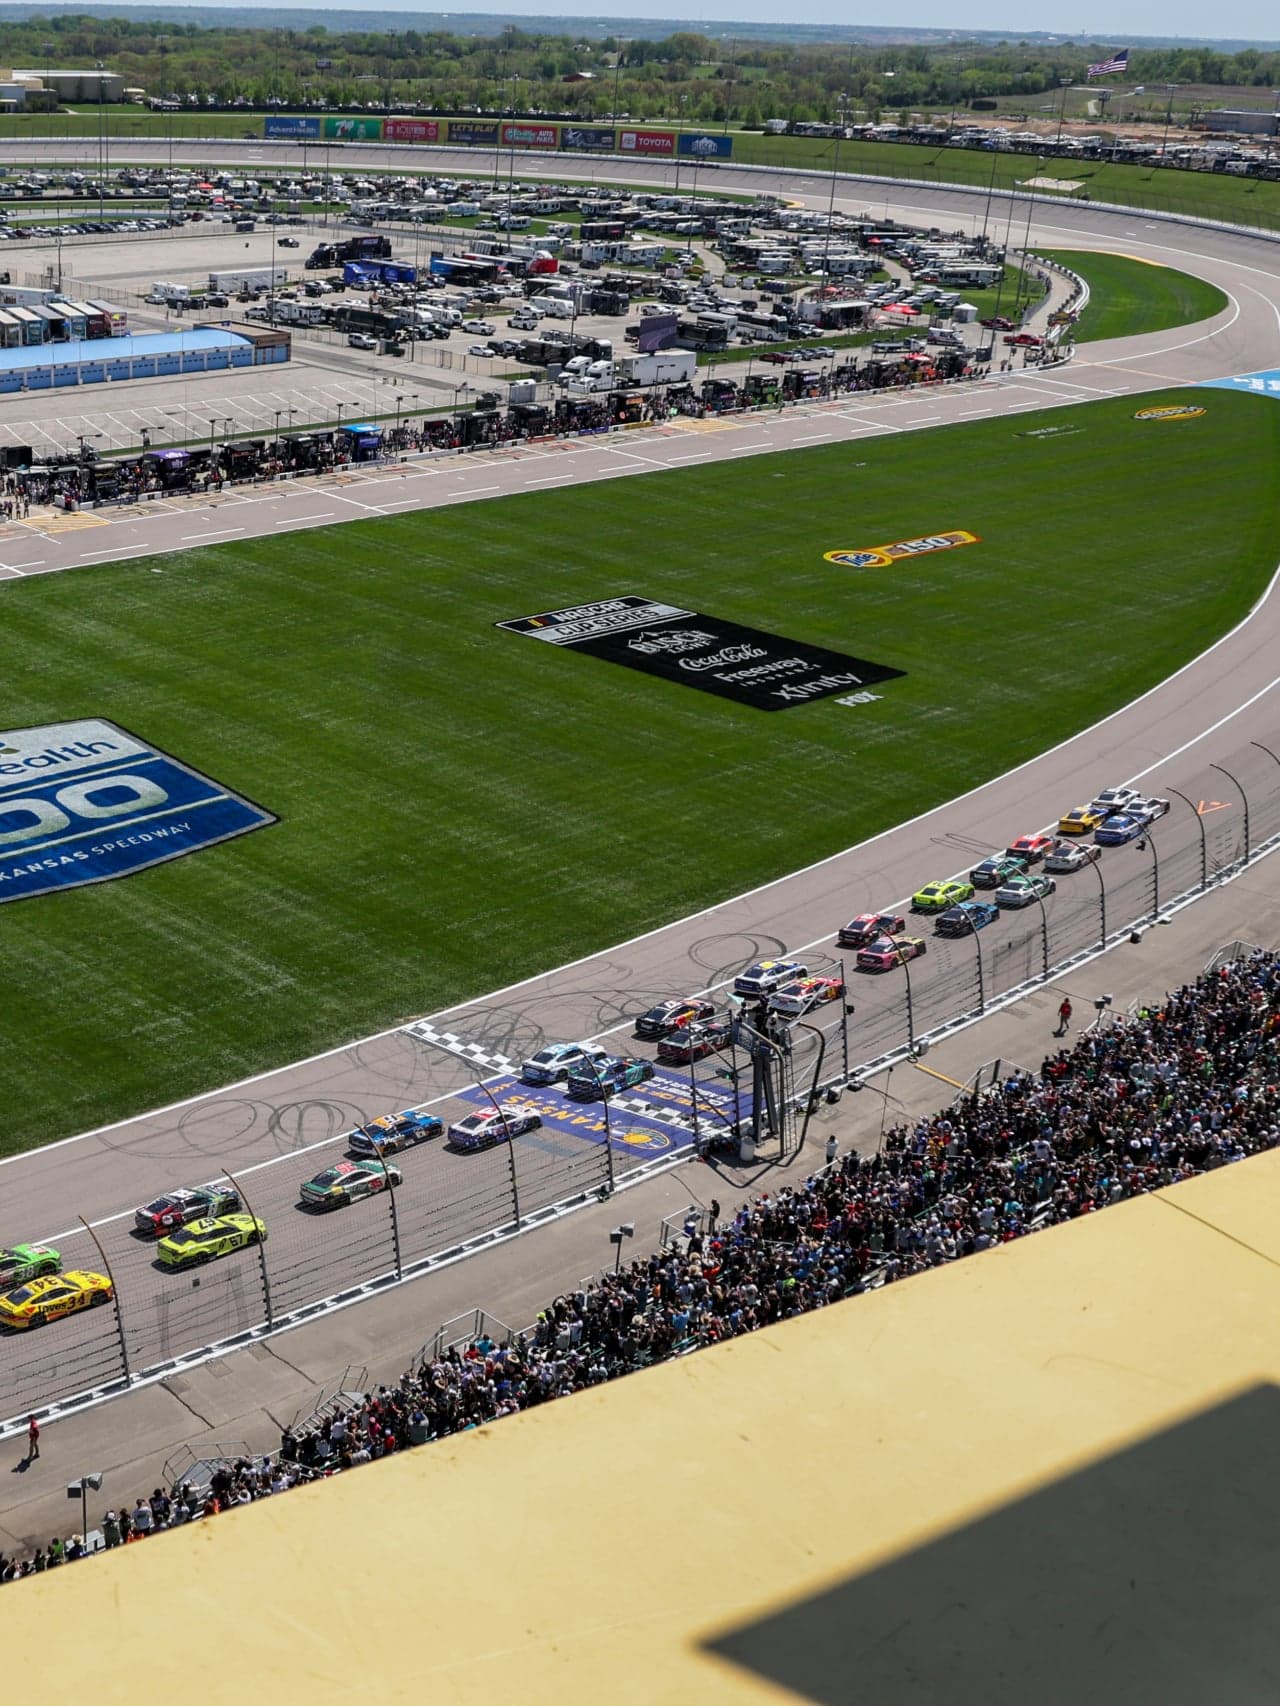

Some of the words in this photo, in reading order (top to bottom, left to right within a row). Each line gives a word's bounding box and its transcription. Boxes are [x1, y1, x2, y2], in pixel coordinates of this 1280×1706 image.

[268, 125, 318, 135] AdventHealth
[452, 124, 473, 133] LET'S
[475, 124, 496, 134] PLAY
[538, 129, 553, 137] AUTO
[535, 135, 555, 144] PARTS
[637, 136, 672, 147] TOYOTA
[896, 536, 954, 554] 150
[834, 552, 877, 567] Tide
[551, 601, 632, 623] NASCAR
[555, 621, 597, 637] CUP
[596, 608, 660, 629] SERIES
[628, 630, 719, 654] BUSCH
[669, 639, 712, 655] LIGHT
[712, 656, 811, 683] Freeway
[770, 672, 864, 700] xfinity
[833, 691, 885, 708] FOX
[91, 821, 192, 856] SPEEDWAY
[503, 1094, 607, 1132] KANSAS
[228, 1234, 243, 1248] 67
[17, 1264, 35, 1281] 38
[34, 1276, 58, 1290] 34
[66, 1291, 85, 1311] 34
